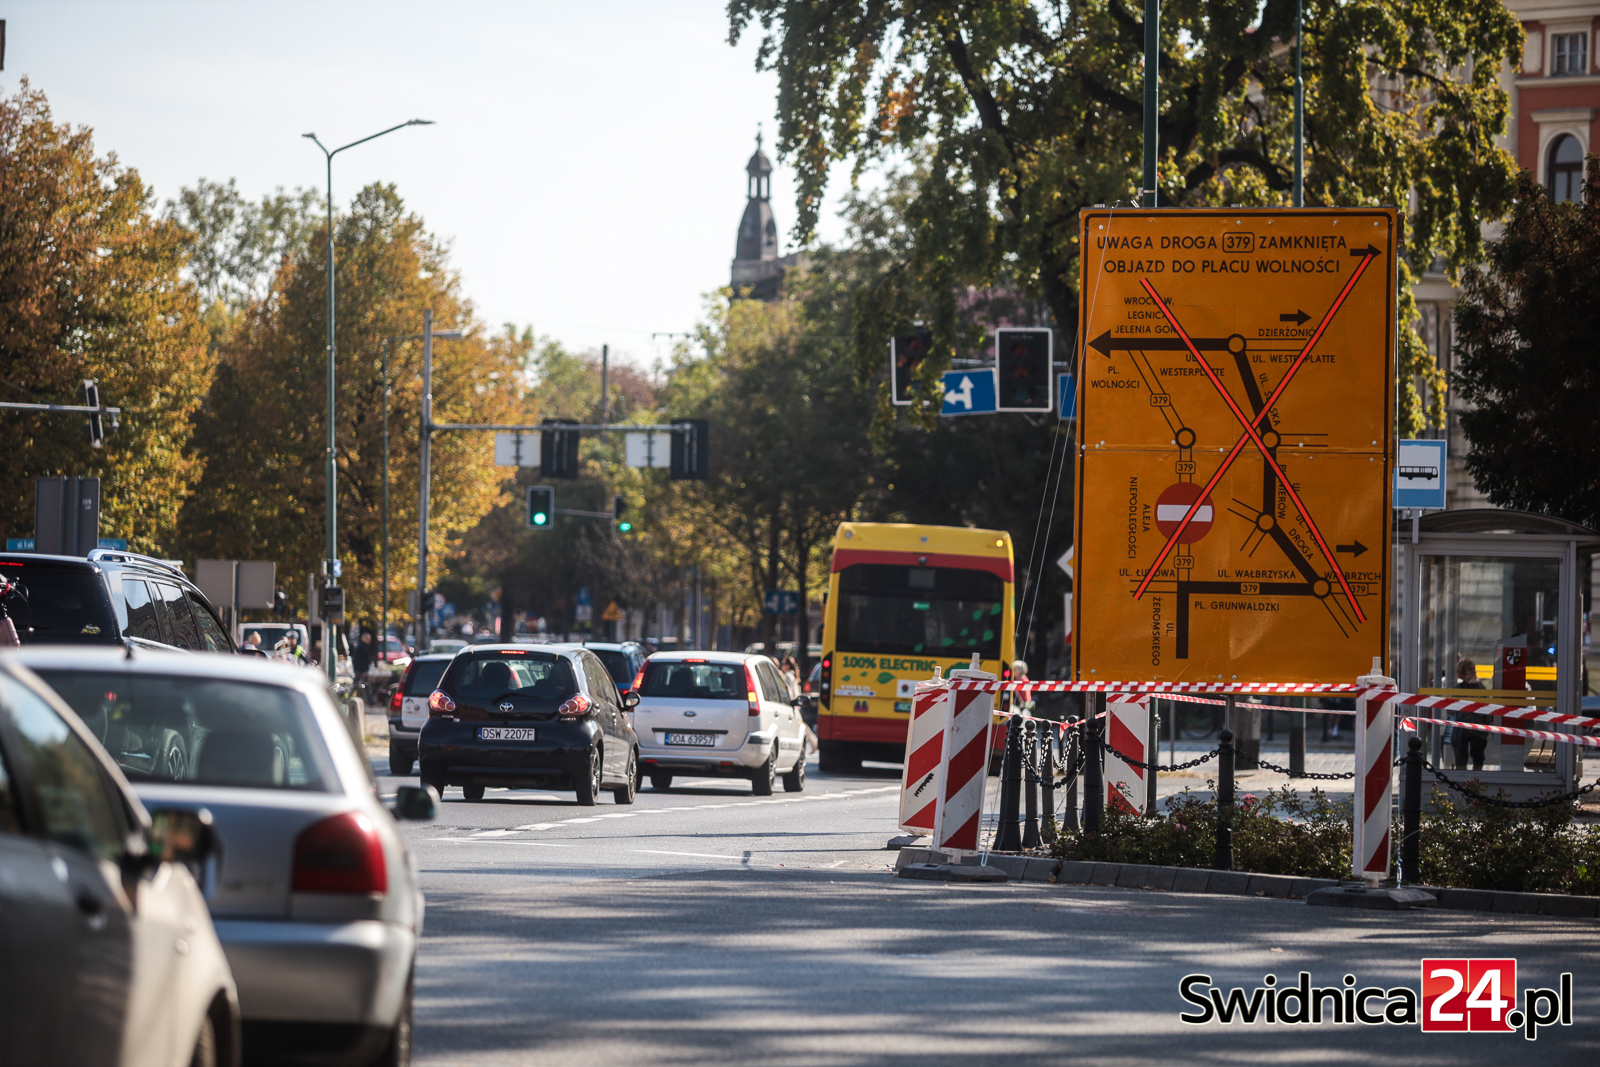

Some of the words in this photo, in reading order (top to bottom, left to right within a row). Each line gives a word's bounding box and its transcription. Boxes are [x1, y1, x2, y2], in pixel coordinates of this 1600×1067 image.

[1097, 236, 1153, 249] UWAGA
[1161, 236, 1217, 249] DROGA
[1227, 236, 1251, 249] 379
[1259, 236, 1347, 252] ZAMKNIĘTA
[1104, 260, 1165, 273] OBJAZD
[1172, 260, 1195, 273] DO
[1202, 260, 1250, 273] PLACU
[1256, 256, 1339, 273] WOLNOŚCI
[1115, 325, 1151, 333] JELENIA
[1155, 323, 1179, 333] GÓR
[1259, 326, 1323, 337] DZIERŻONIÓ
[1253, 355, 1266, 363] UL.
[1108, 366, 1120, 374] PL.
[1160, 368, 1225, 376] WESTERPLTE
[1091, 378, 1140, 389] WOLNOŚCI
[1153, 396, 1168, 405] 379
[1178, 464, 1193, 472] 379
[1128, 477, 1138, 558] NIEPODLEGŁOŚCI
[1142, 504, 1151, 532] ALEJA
[1288, 528, 1314, 560] DROGA
[1176, 559, 1191, 567] 379
[1119, 569, 1132, 577] UL.
[1136, 569, 1175, 577] ŁUOWA
[1218, 569, 1231, 578] UL.
[1235, 570, 1296, 579] WAŁBRZYSKA
[1324, 572, 1381, 580] WABRZYCH
[1243, 585, 1258, 593] 379
[1350, 585, 1366, 593] 379
[1194, 601, 1207, 610] PL.
[1211, 601, 1280, 611] GRUNWALDZKI
[1152, 596, 1163, 666] ŻEROMSKIEGO
[1166, 622, 1175, 636] UL.
[842, 656, 877, 669] 100%
[880, 658, 937, 672] ELECTRIC
[482, 729, 501, 739] DSW
[504, 729, 533, 739] 2207F
[688, 735, 713, 745] 63957
